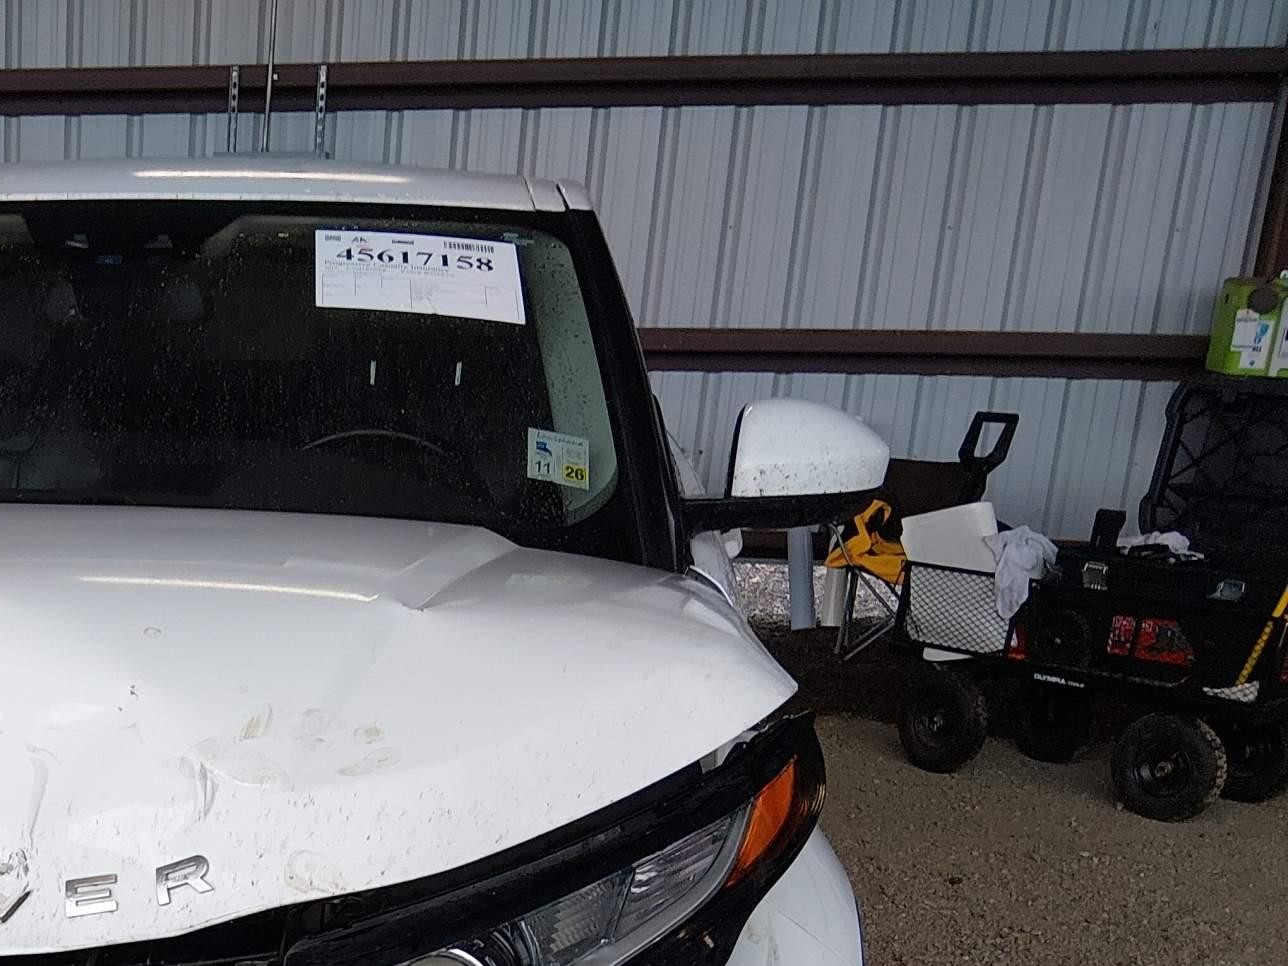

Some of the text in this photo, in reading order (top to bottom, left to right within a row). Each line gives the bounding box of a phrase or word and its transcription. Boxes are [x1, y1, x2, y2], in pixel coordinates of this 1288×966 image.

[336, 247, 494, 272] 45617158
[535, 461, 585, 481] 11 26
